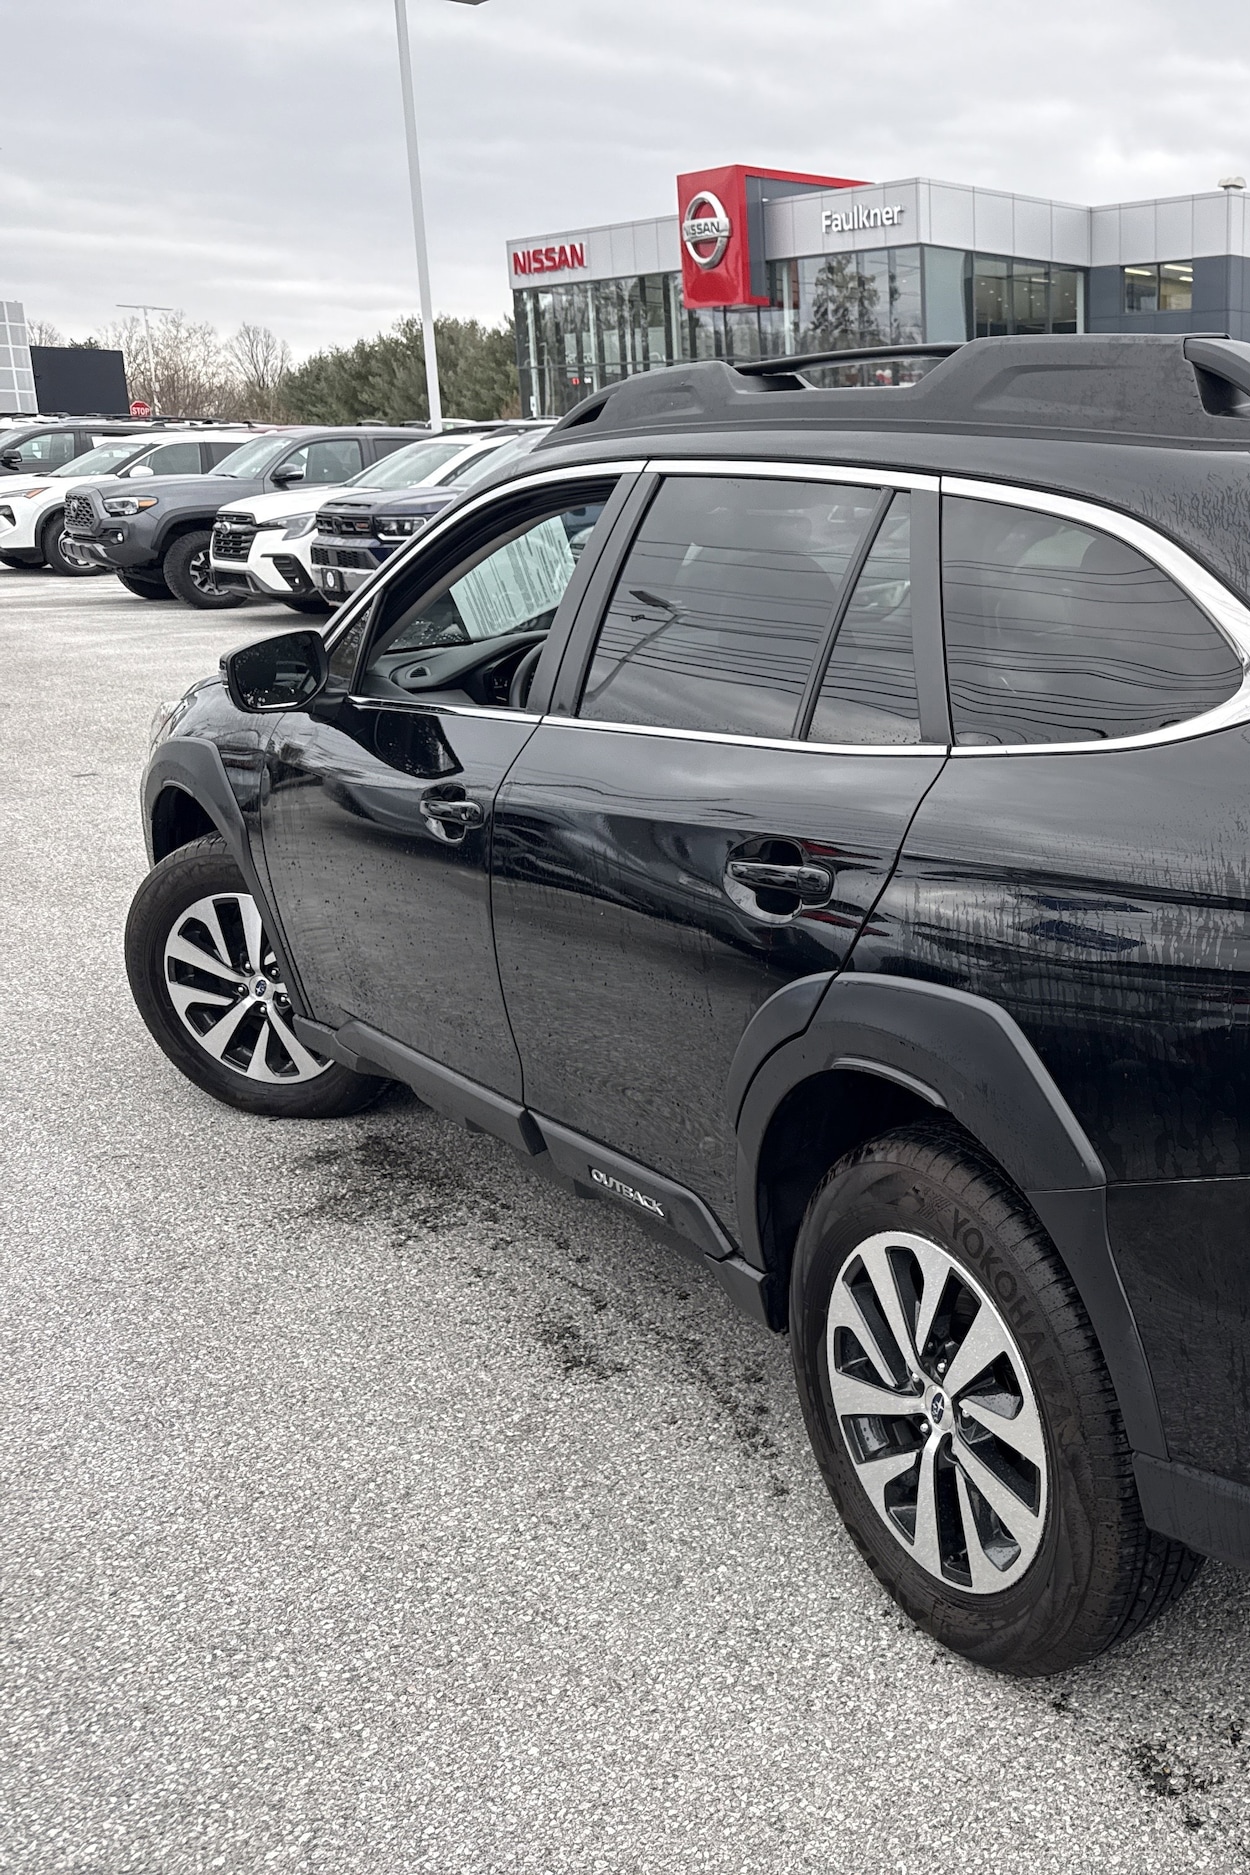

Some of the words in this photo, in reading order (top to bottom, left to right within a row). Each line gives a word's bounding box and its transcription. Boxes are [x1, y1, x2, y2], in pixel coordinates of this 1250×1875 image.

[821, 204, 902, 233] Faulkner
[512, 242, 585, 275] NISSAN
[132, 406, 150, 416] STOP
[590, 1168, 665, 1217] OUTBACK
